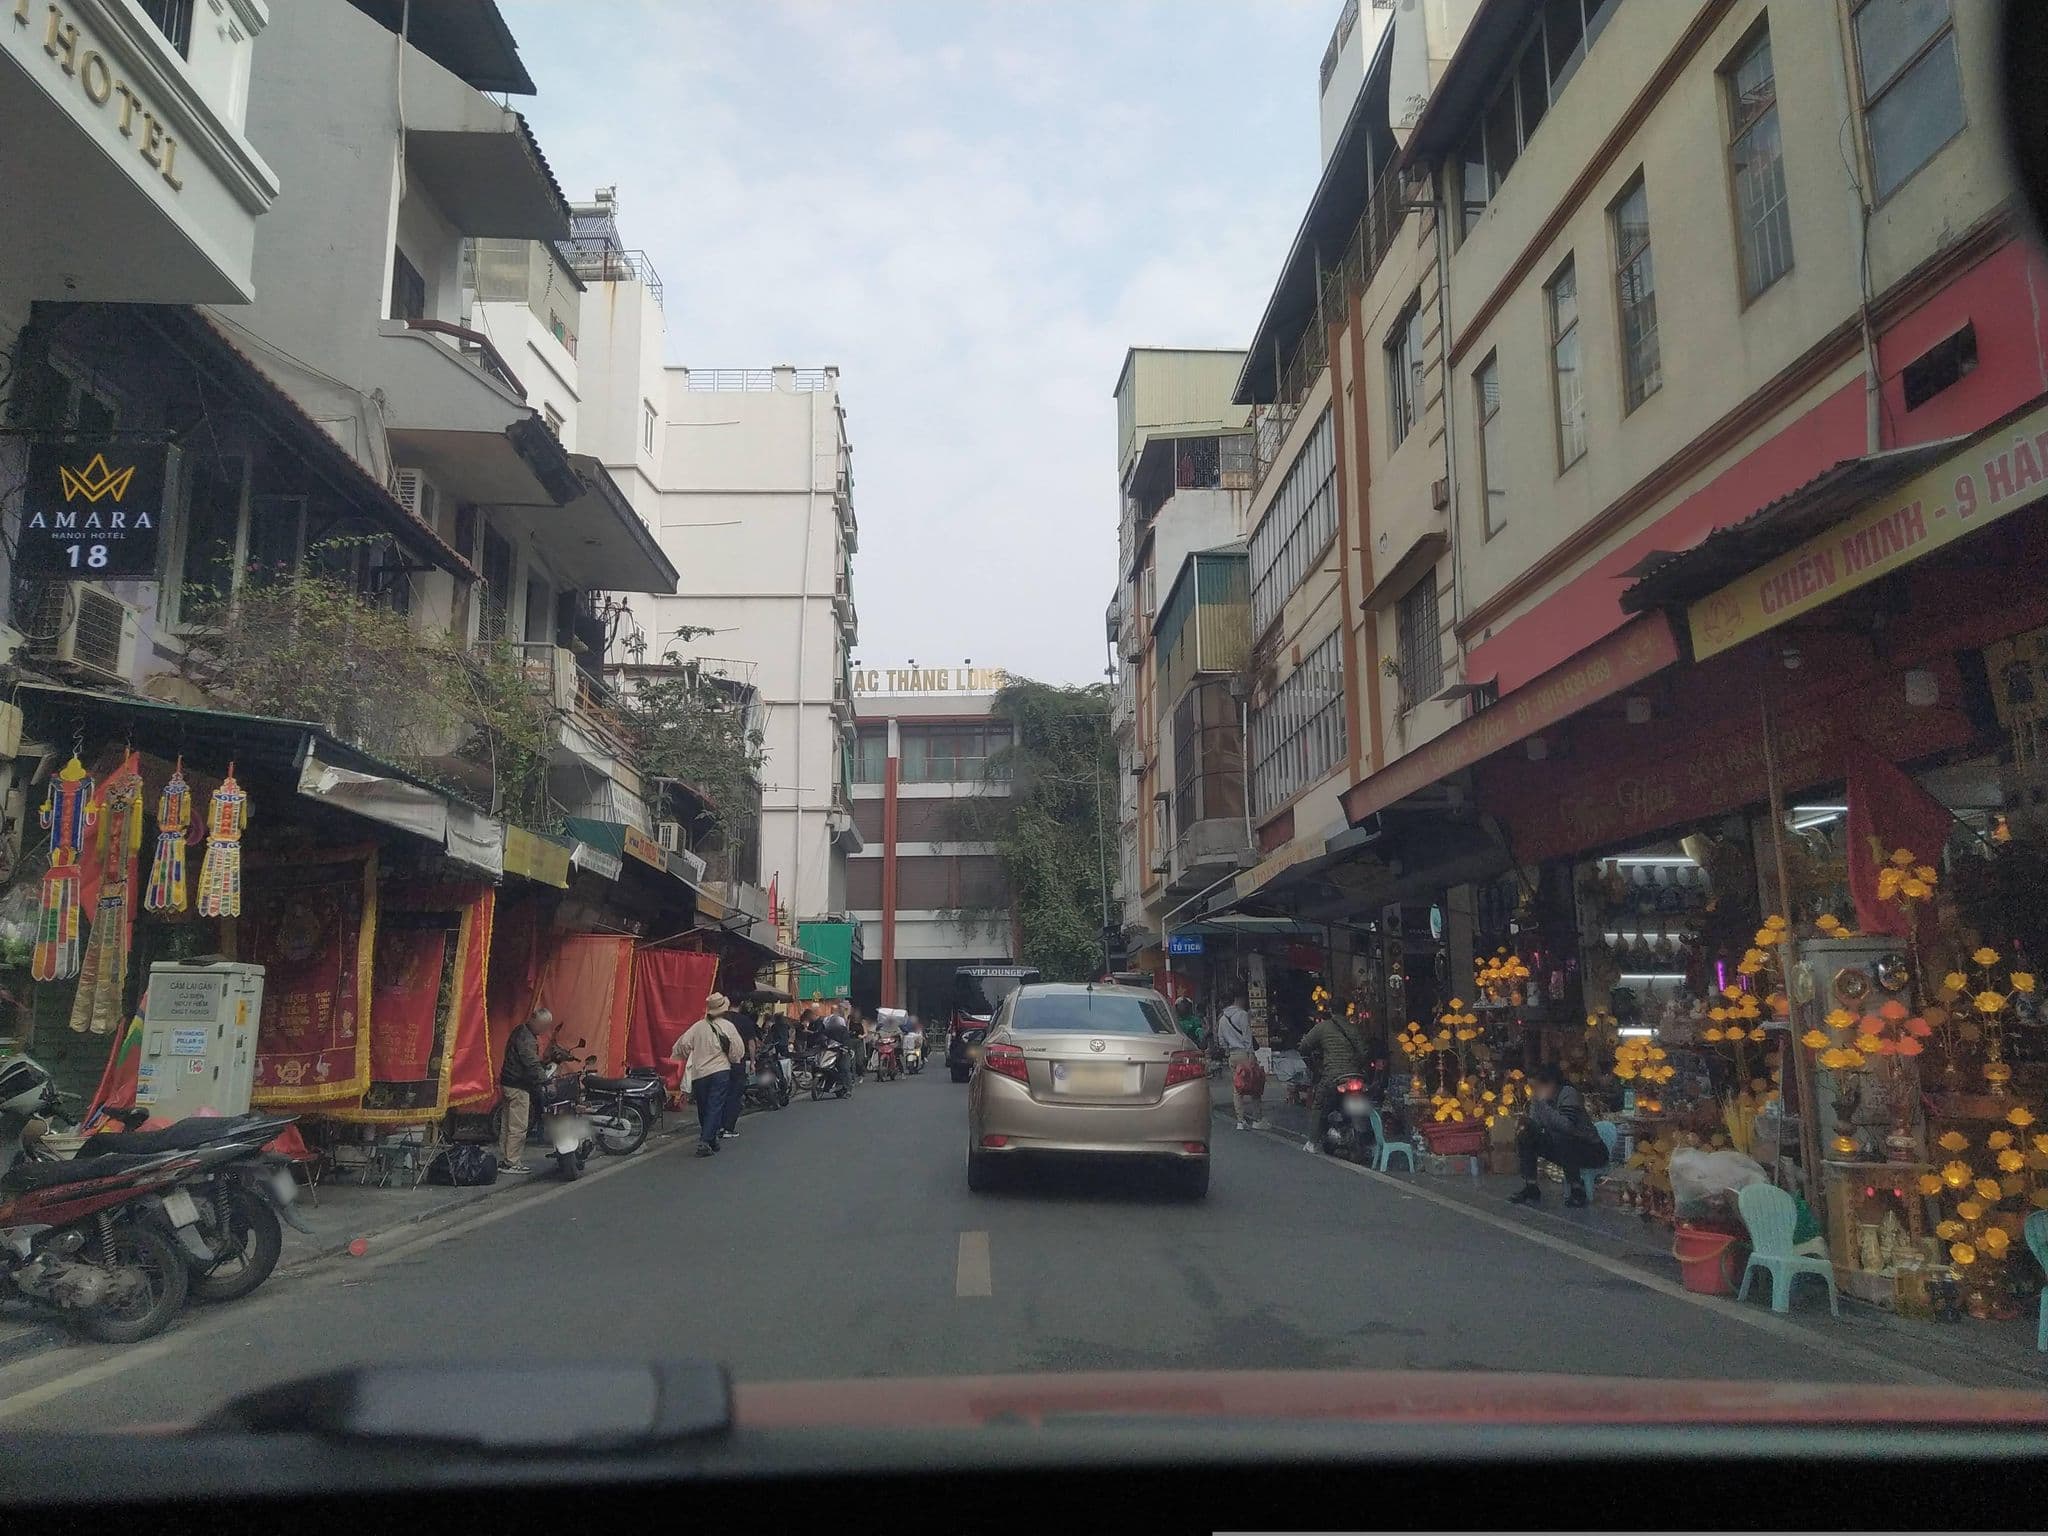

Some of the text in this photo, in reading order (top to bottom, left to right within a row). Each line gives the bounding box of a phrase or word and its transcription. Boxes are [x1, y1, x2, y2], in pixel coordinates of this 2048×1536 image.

[43, 4, 183, 193] HOTEL
[28, 511, 153, 529] AMARA
[1840, 501, 1928, 577] MINH
[1954, 474, 1978, 520] 9
[66, 544, 108, 568] 18
[972, 968, 1022, 976] VIP LOUNGE
